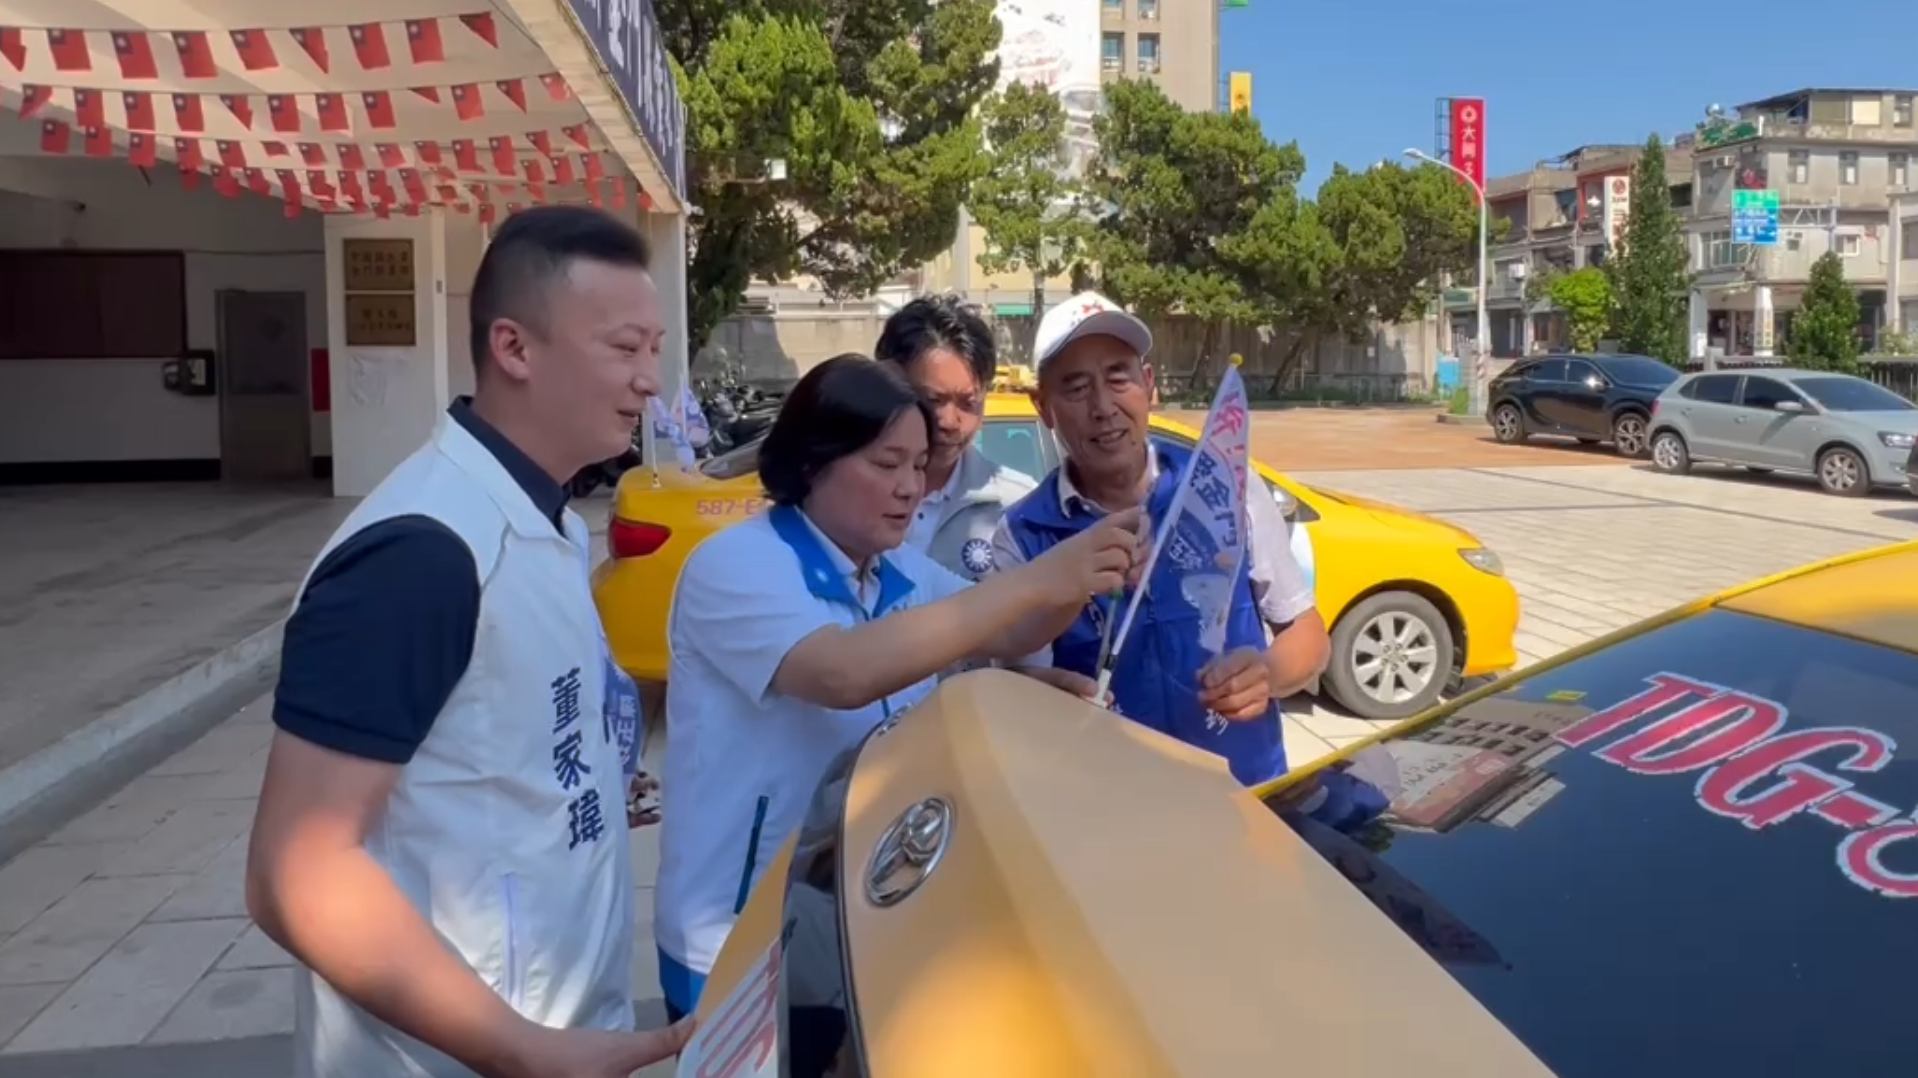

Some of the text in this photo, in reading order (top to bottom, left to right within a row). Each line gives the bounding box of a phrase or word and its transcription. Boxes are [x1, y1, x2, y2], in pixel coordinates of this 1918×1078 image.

[696, 499, 763, 516] 587-E
[550, 667, 605, 852] 董家瑋
